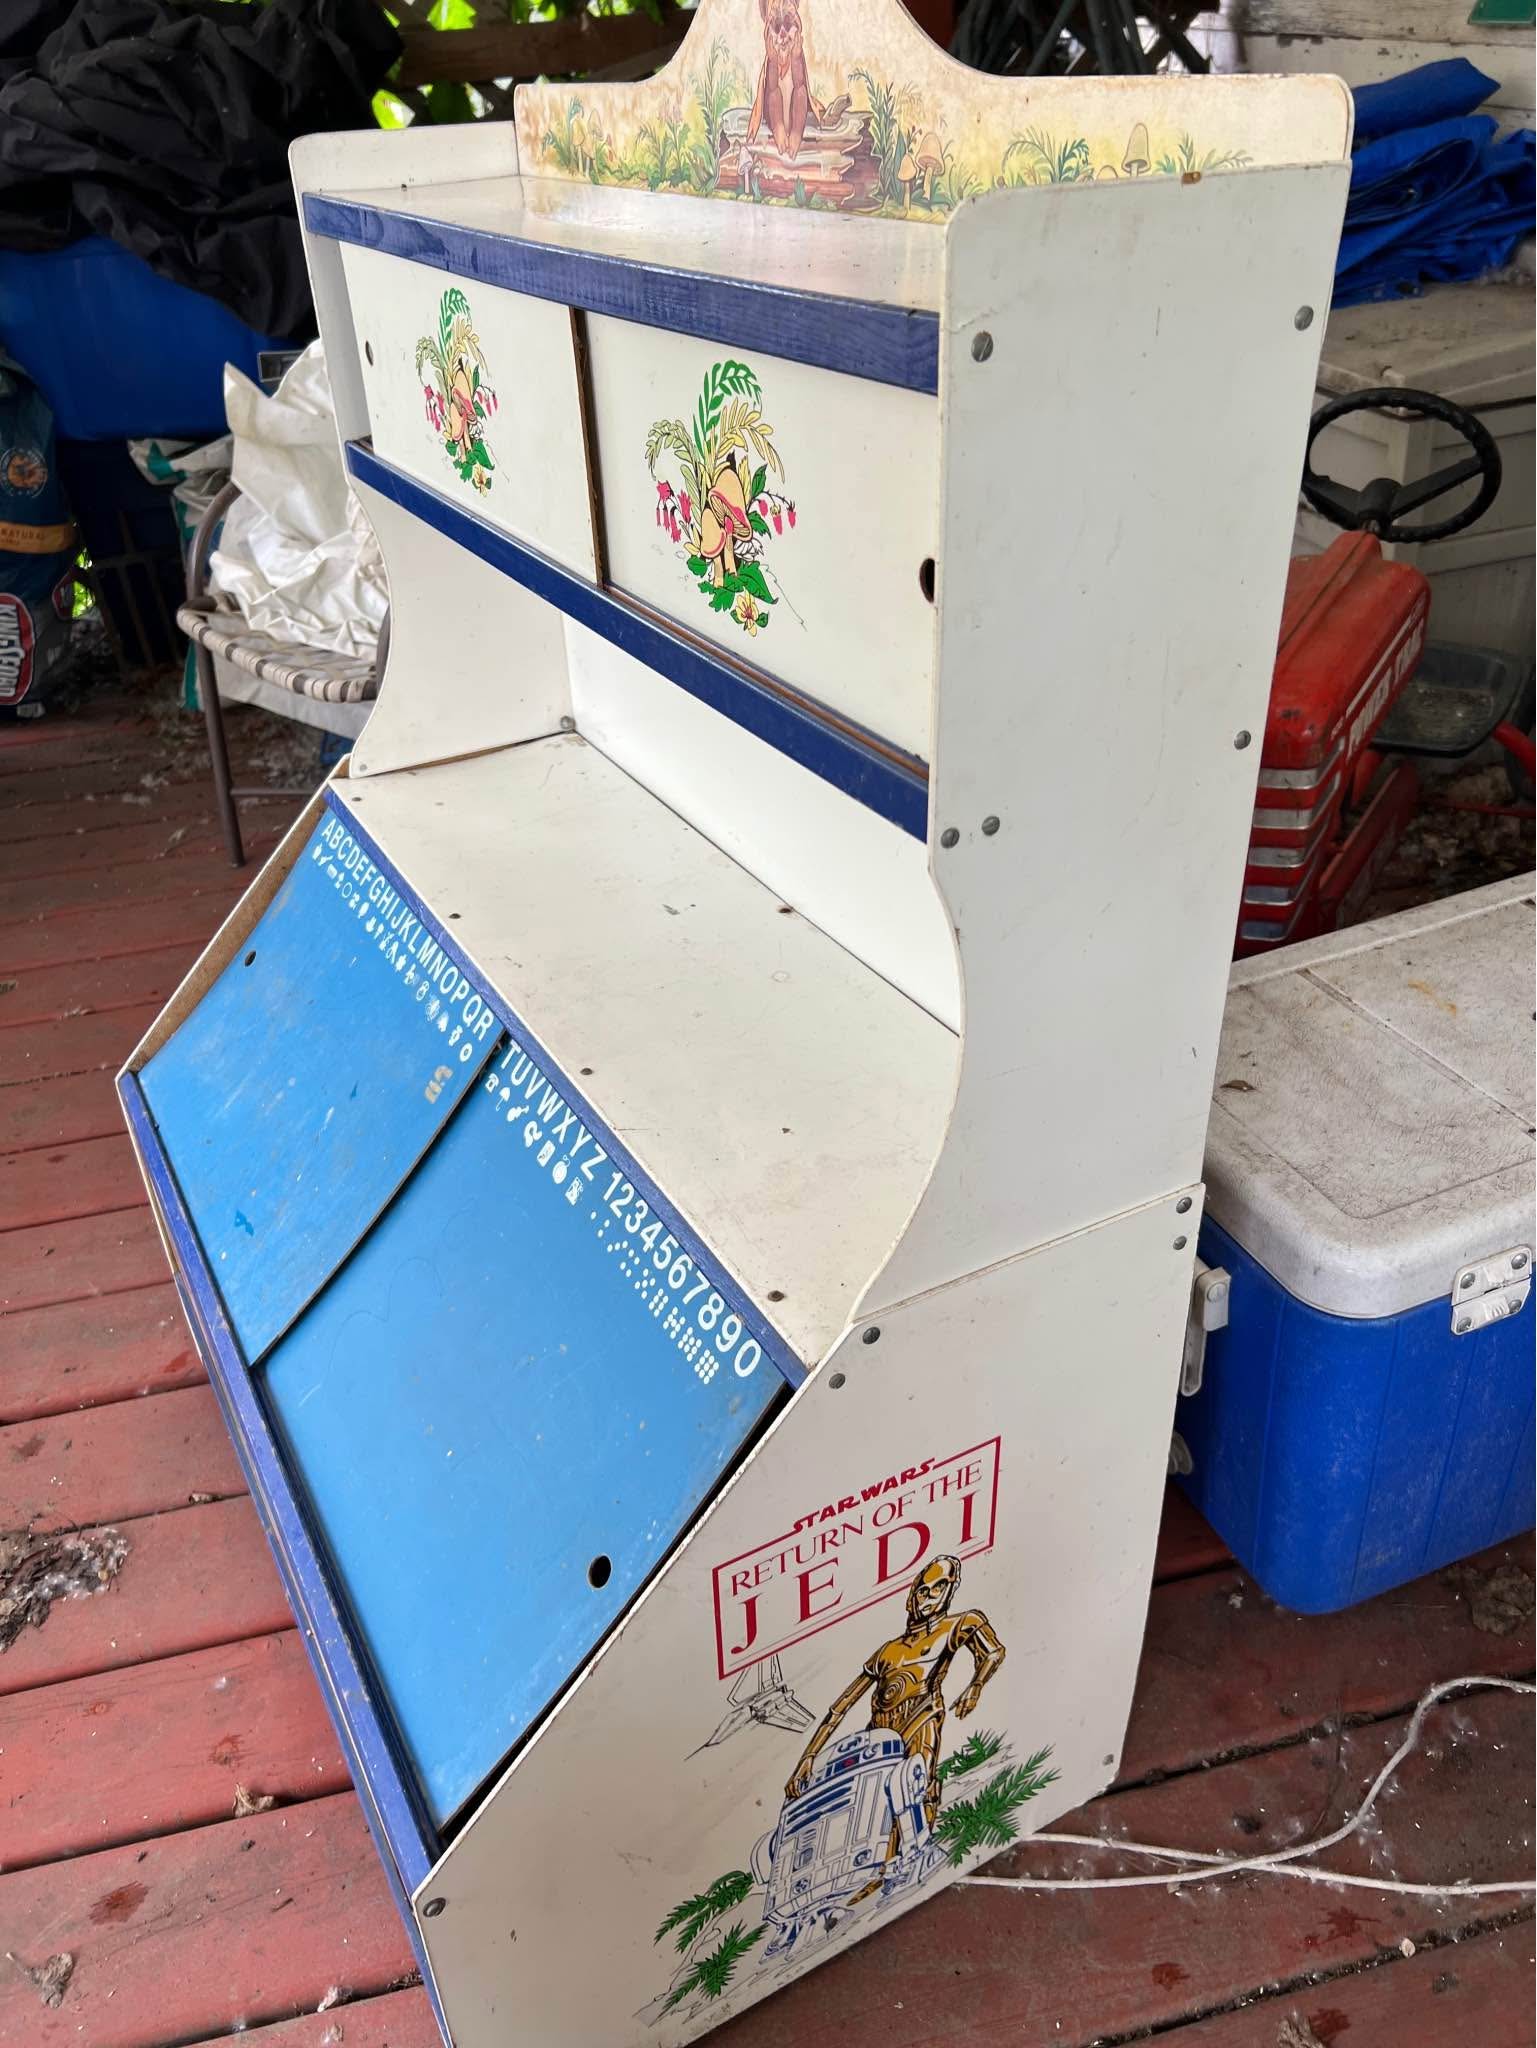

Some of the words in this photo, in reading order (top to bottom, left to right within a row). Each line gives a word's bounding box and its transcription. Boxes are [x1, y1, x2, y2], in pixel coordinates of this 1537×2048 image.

[321, 817, 494, 1041] ABCDEFGHIJKLMNOPQR
[603, 1170, 762, 1378] 1234567890
[730, 1514, 864, 1597] RETURN
[871, 1489, 917, 1528] OF
[921, 1459, 983, 1504] THE
[792, 1494, 862, 1533] STAR
[859, 1457, 936, 1504] WARS
[729, 1490, 985, 1655] JEDI
